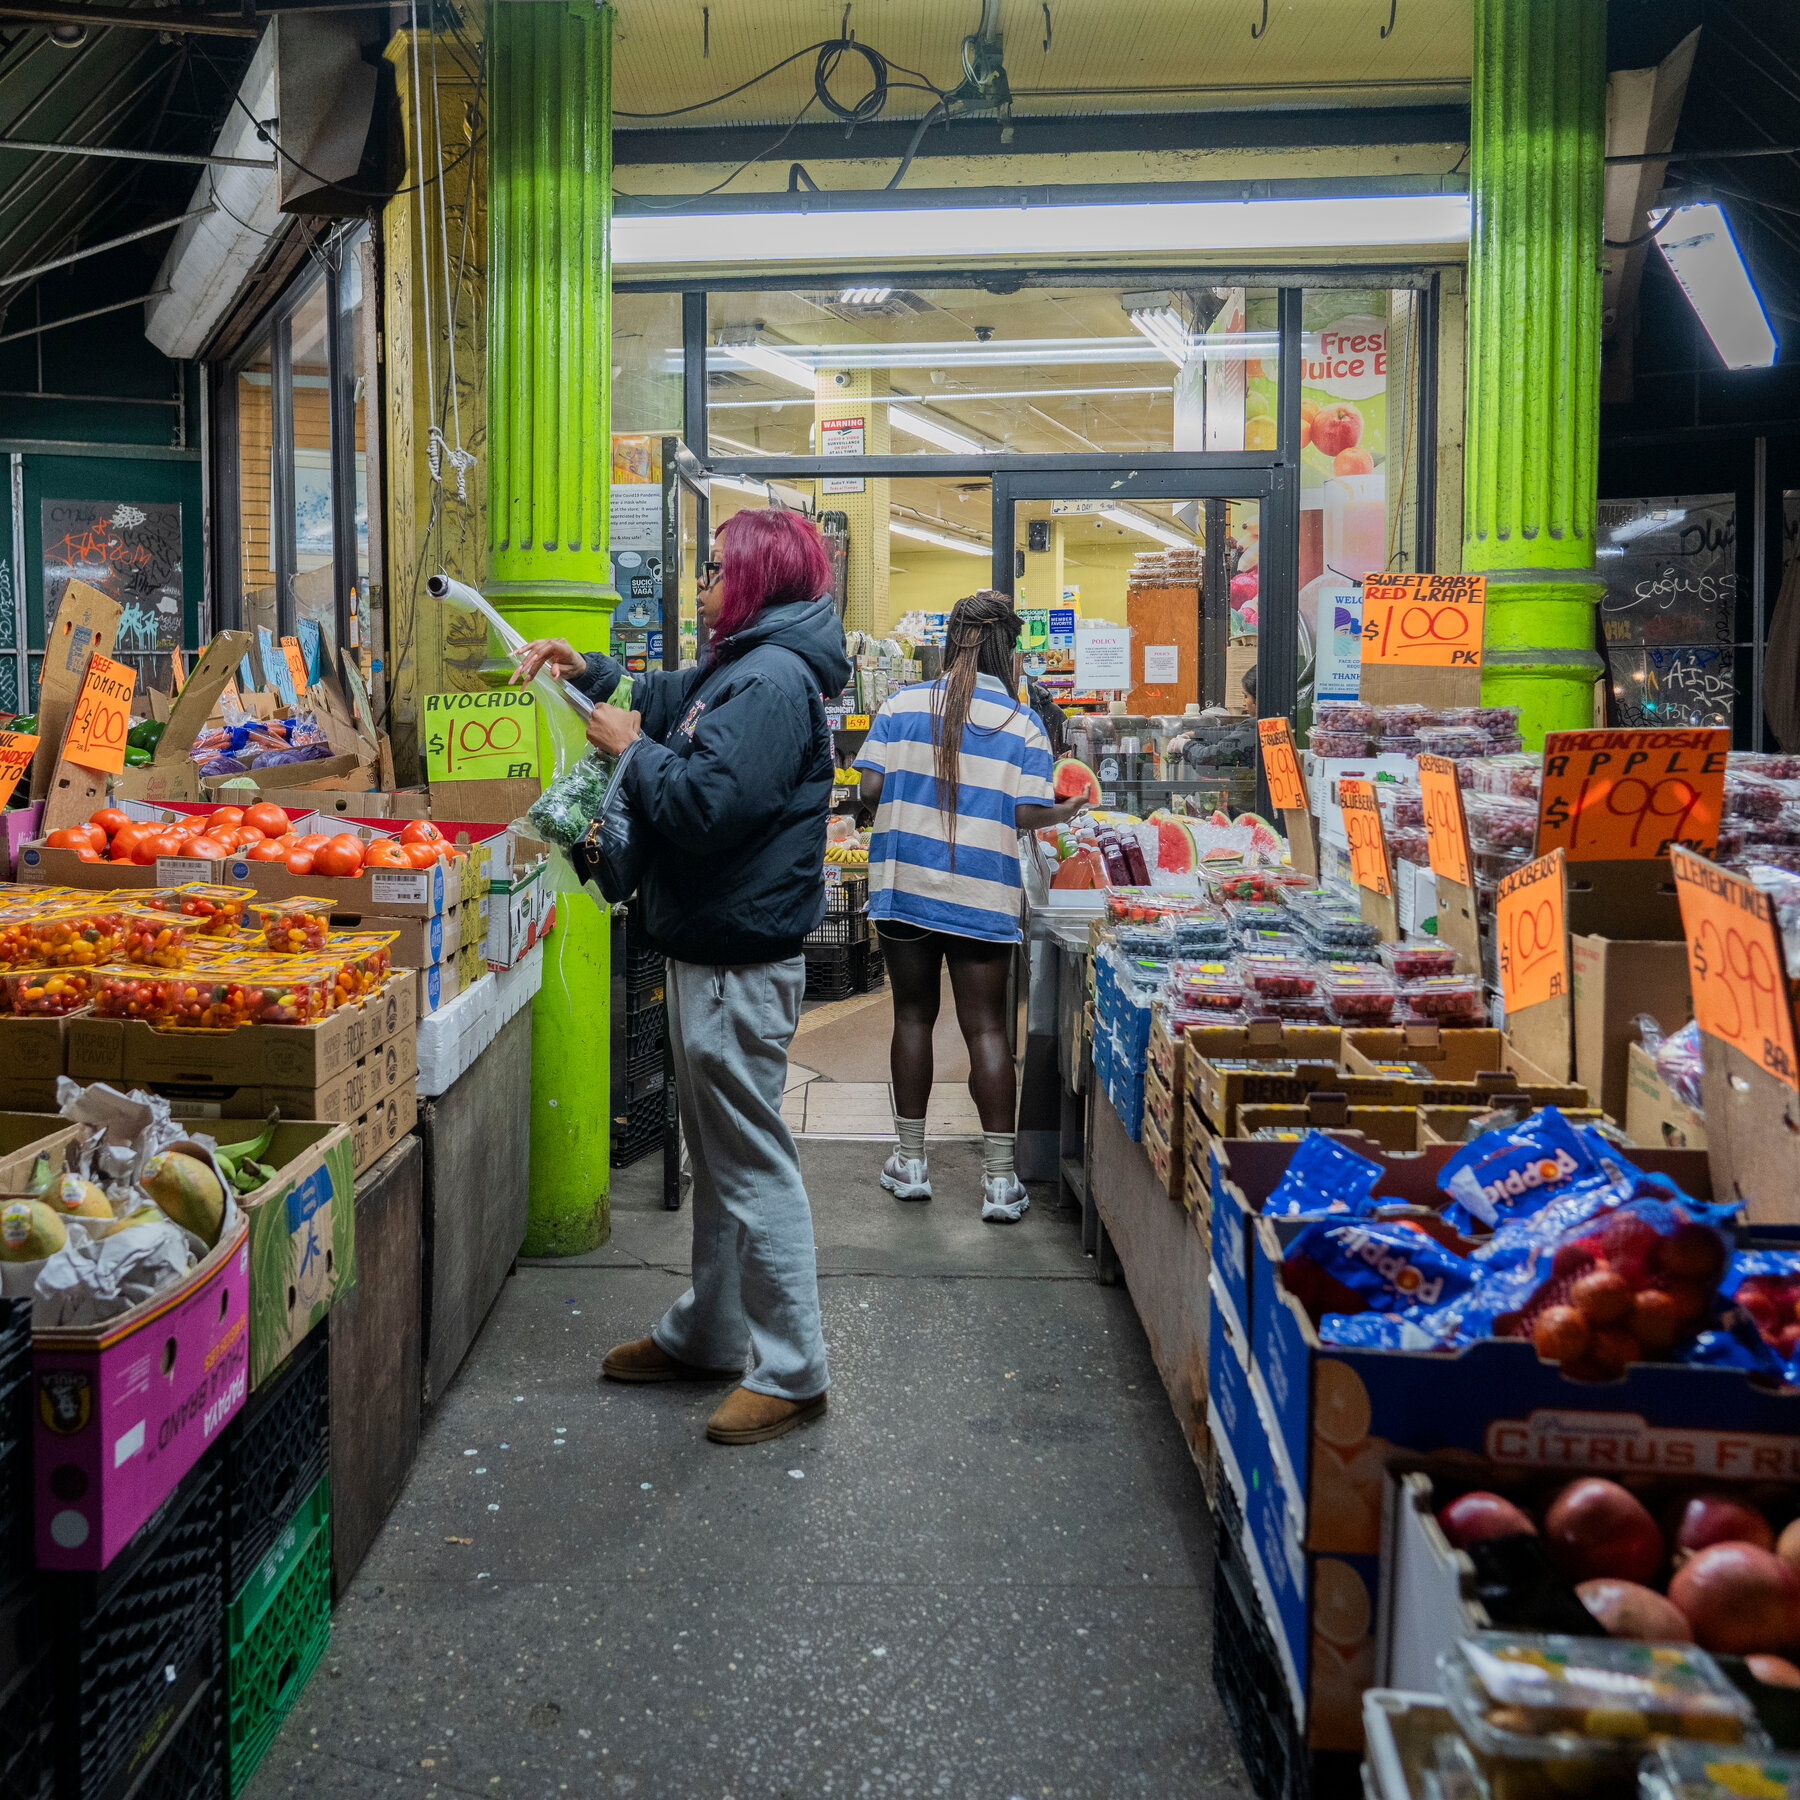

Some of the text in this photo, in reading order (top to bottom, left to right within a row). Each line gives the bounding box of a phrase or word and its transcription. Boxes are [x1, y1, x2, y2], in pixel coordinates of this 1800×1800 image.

[823, 419, 863, 428] WARNING
[1365, 573, 1481, 589] SWEET BABY
[1365, 586, 1407, 600] RED
[91, 654, 113, 673] BEEF
[1450, 650, 1479, 665] PK
[86, 672, 132, 702] TOMATO
[427, 691, 534, 711] AVOCADO
[1548, 731, 1715, 755] MACINTOSH
[507, 762, 532, 778] EA
[1546, 751, 1726, 777] APPLE
[1338, 779, 1360, 794] JUMBO
[1674, 852, 1770, 923] CLEMENTINE
[203, 1368, 245, 1438] PAPAYA
[157, 1380, 207, 1452] BRAND
[1495, 1428, 1695, 1468] CITRUS
